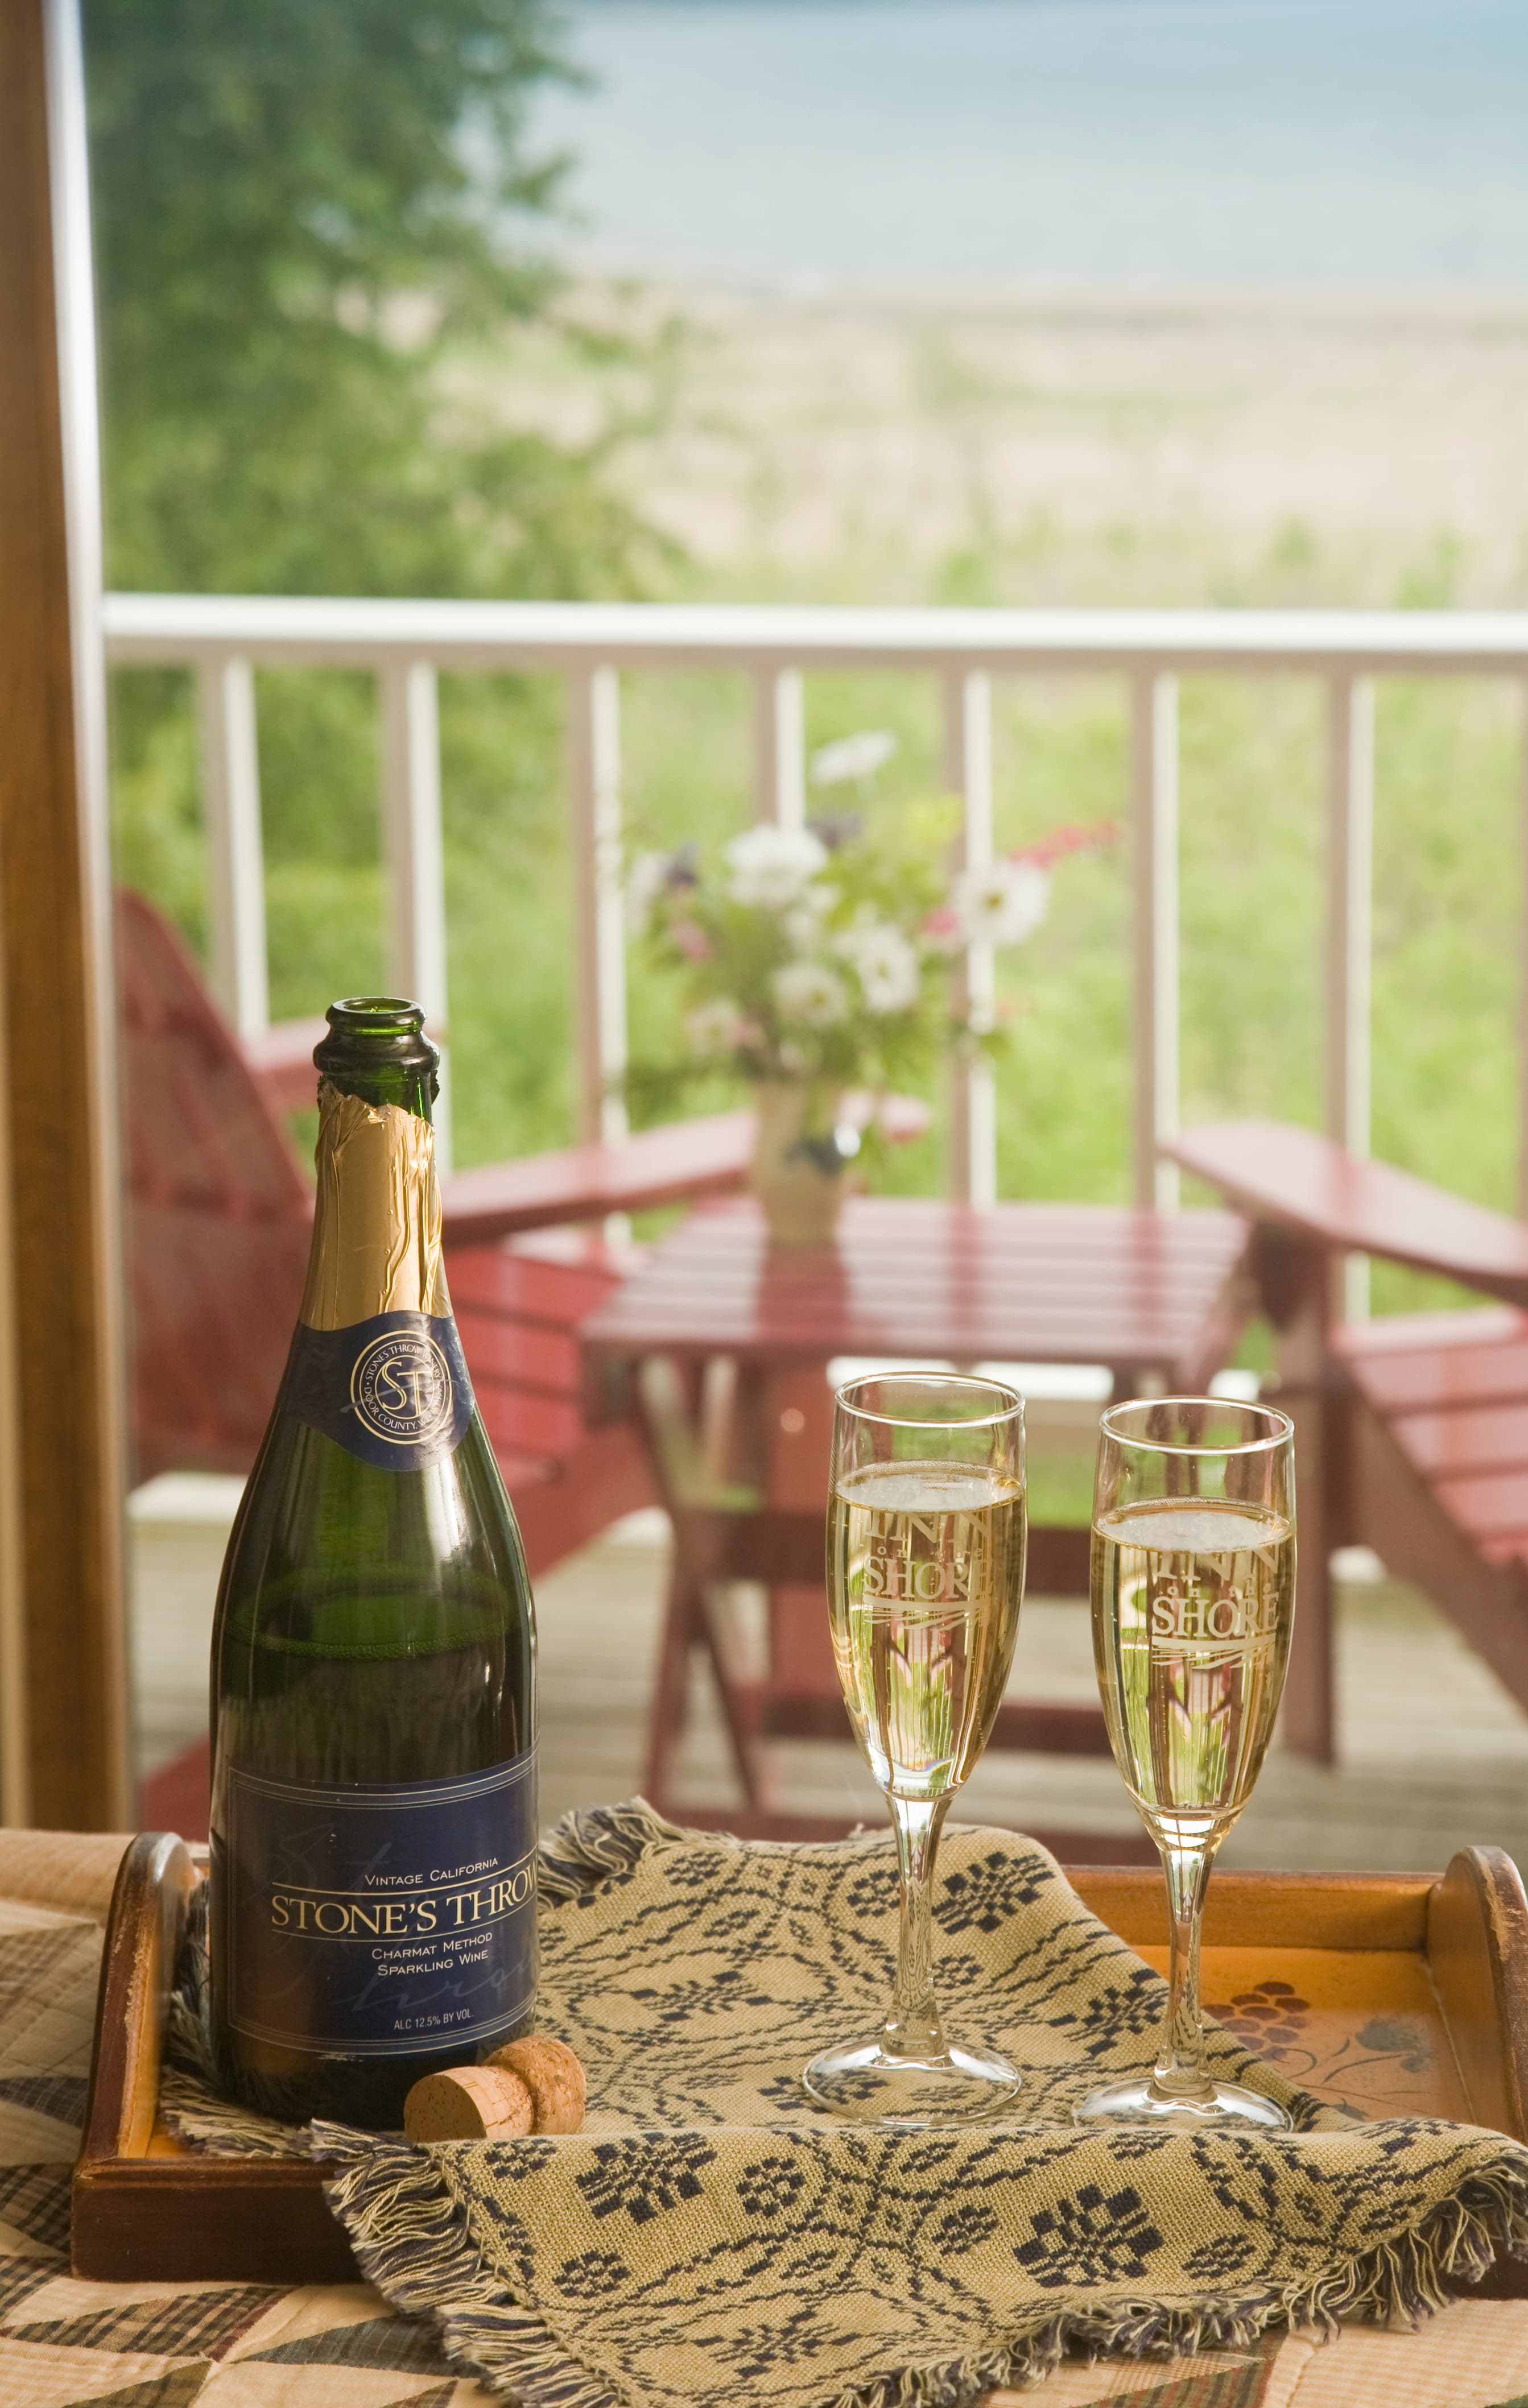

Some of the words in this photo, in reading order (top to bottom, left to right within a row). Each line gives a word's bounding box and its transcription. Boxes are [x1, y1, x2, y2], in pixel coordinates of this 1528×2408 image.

[365, 1350, 389, 1380] STONE'S
[389, 1343, 422, 1355] THROW
[364, 1387, 380, 1415] DOOR
[1151, 1592, 1279, 1639] SHORE
[365, 1874, 424, 1886] VINTAGE
[430, 1857, 498, 1882] CALIFORNIA
[271, 1894, 437, 1935] STONE'S
[371, 1945, 437, 1960] CHARMAT
[443, 1932, 493, 1953] METHOD
[377, 1959, 453, 1976] SPARKLING
[459, 1950, 489, 1966] WINE
[394, 2018, 412, 2030] ALC
[415, 2016, 441, 2029] 12.5%
[443, 2011, 455, 2024] BY
[456, 2008, 474, 2020] VOL.
